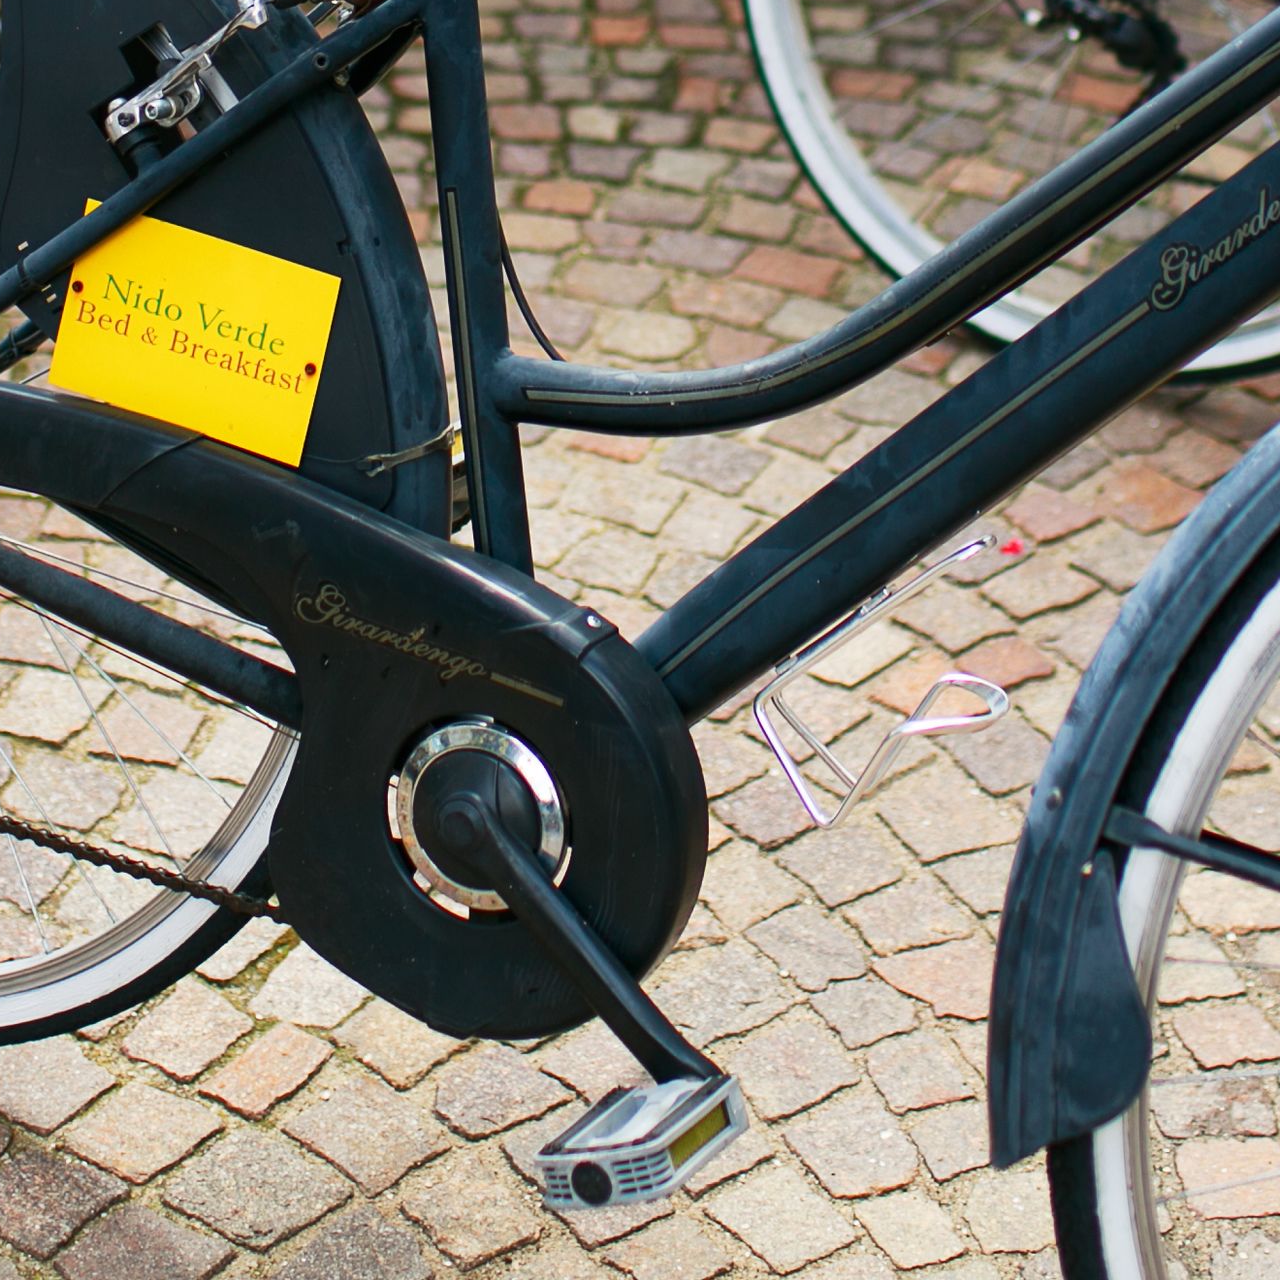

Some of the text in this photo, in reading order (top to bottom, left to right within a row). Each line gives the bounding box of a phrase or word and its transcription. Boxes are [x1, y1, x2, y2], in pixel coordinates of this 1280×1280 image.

[75, 300, 304, 395] Bed & Breakfast
[102, 273, 286, 356] Nido Verde
[294, 583, 487, 680] Girardengo
